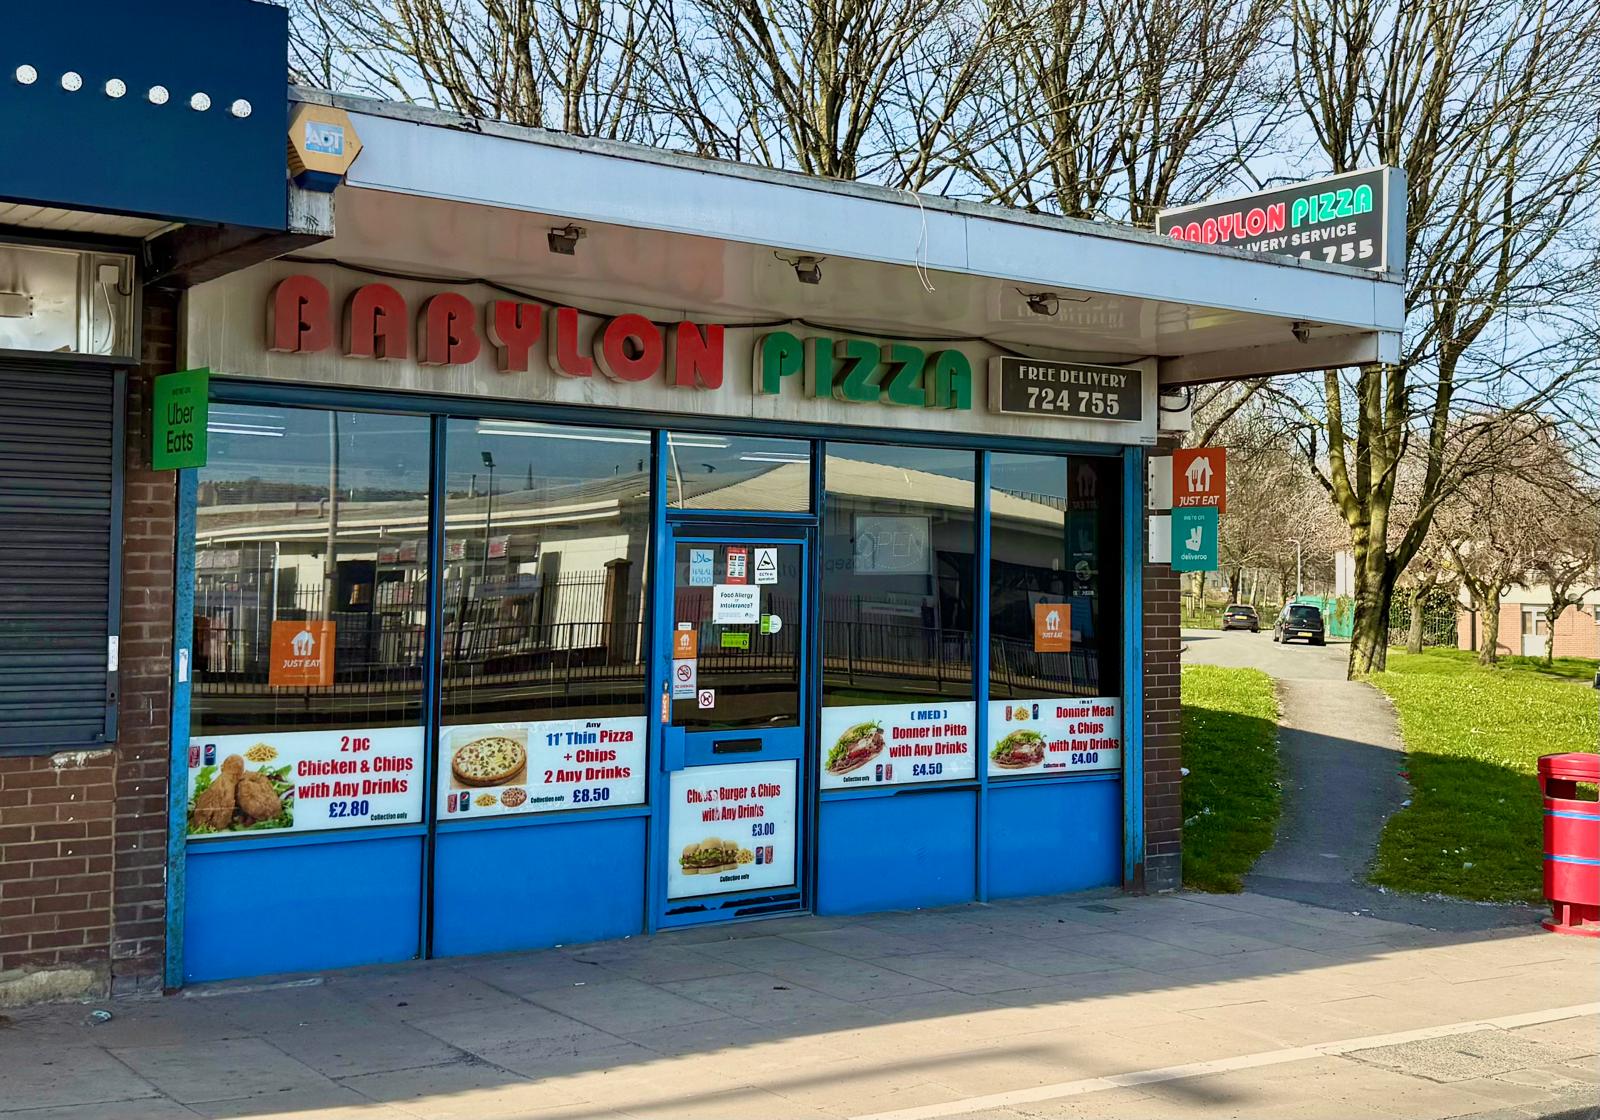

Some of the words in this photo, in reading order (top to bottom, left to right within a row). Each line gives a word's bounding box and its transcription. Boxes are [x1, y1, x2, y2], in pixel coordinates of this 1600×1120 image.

[310, 129, 343, 149] ADT
[1291, 184, 1373, 228] PIZZA
[1234, 235, 1289, 253] IVERY
[1291, 222, 1357, 246] SERVICE
[1322, 239, 1374, 264] 755
[267, 274, 725, 390] BABYLON
[752, 331, 972, 411] PIZZA
[1019, 365, 1056, 382] FREE
[1060, 369, 1127, 388] DELIVERY
[1027, 386, 1071, 412] 724
[1078, 391, 1120, 415] 755
[167, 402, 194, 425] Uber
[166, 430, 193, 453] Eats
[1179, 496, 1201, 507] JUST
[1202, 495, 1220, 505] EAT
[1180, 552, 1208, 561] deliveroo
[734, 592, 754, 600] Allergy
[283, 660, 303, 669] JUST
[304, 660, 320, 668] EAT
[917, 709, 941, 720] MED
[1056, 706, 1091, 719] Donner
[1091, 705, 1115, 717] Meat
[585, 721, 602, 729] Any
[892, 726, 931, 740] Donner
[931, 724, 942, 738] in
[944, 723, 968, 736] Pitta
[1068, 724, 1076, 735] &
[1077, 722, 1104, 734] Chips
[340, 736, 350, 752] 2
[352, 737, 371, 753] pc
[566, 731, 597, 745] Thin
[599, 729, 634, 743] Pizza
[1048, 739, 1070, 752] with
[1070, 739, 1088, 752] Any
[1089, 737, 1120, 750] Drinks
[563, 753, 573, 761] +
[575, 749, 617, 763] Chips
[889, 744, 912, 758] with
[913, 743, 933, 757] Any
[934, 741, 968, 755] Drinks
[297, 759, 357, 777] Chicken
[360, 759, 370, 773] &
[373, 755, 413, 772] Chips
[1071, 752, 1098, 765] £4.00
[544, 770, 553, 784] 2
[556, 769, 583, 783] Any
[585, 766, 631, 781] Drinks
[912, 762, 943, 776] £4.50
[298, 783, 330, 799] with
[333, 781, 360, 798] Any
[362, 778, 408, 795] Drinks
[573, 787, 610, 803] £8.50
[686, 788, 719, 804] Ches
[719, 786, 748, 801] Burger
[750, 788, 757, 798] &
[757, 783, 781, 798] Chips
[530, 796, 554, 804] Collection
[554, 795, 565, 803] only
[328, 800, 369, 818] £2.80
[370, 813, 396, 821] Collection
[396, 811, 408, 820] only
[721, 806, 737, 821] Any
[737, 803, 765, 819] Drinks
[751, 822, 775, 837] £3.00
